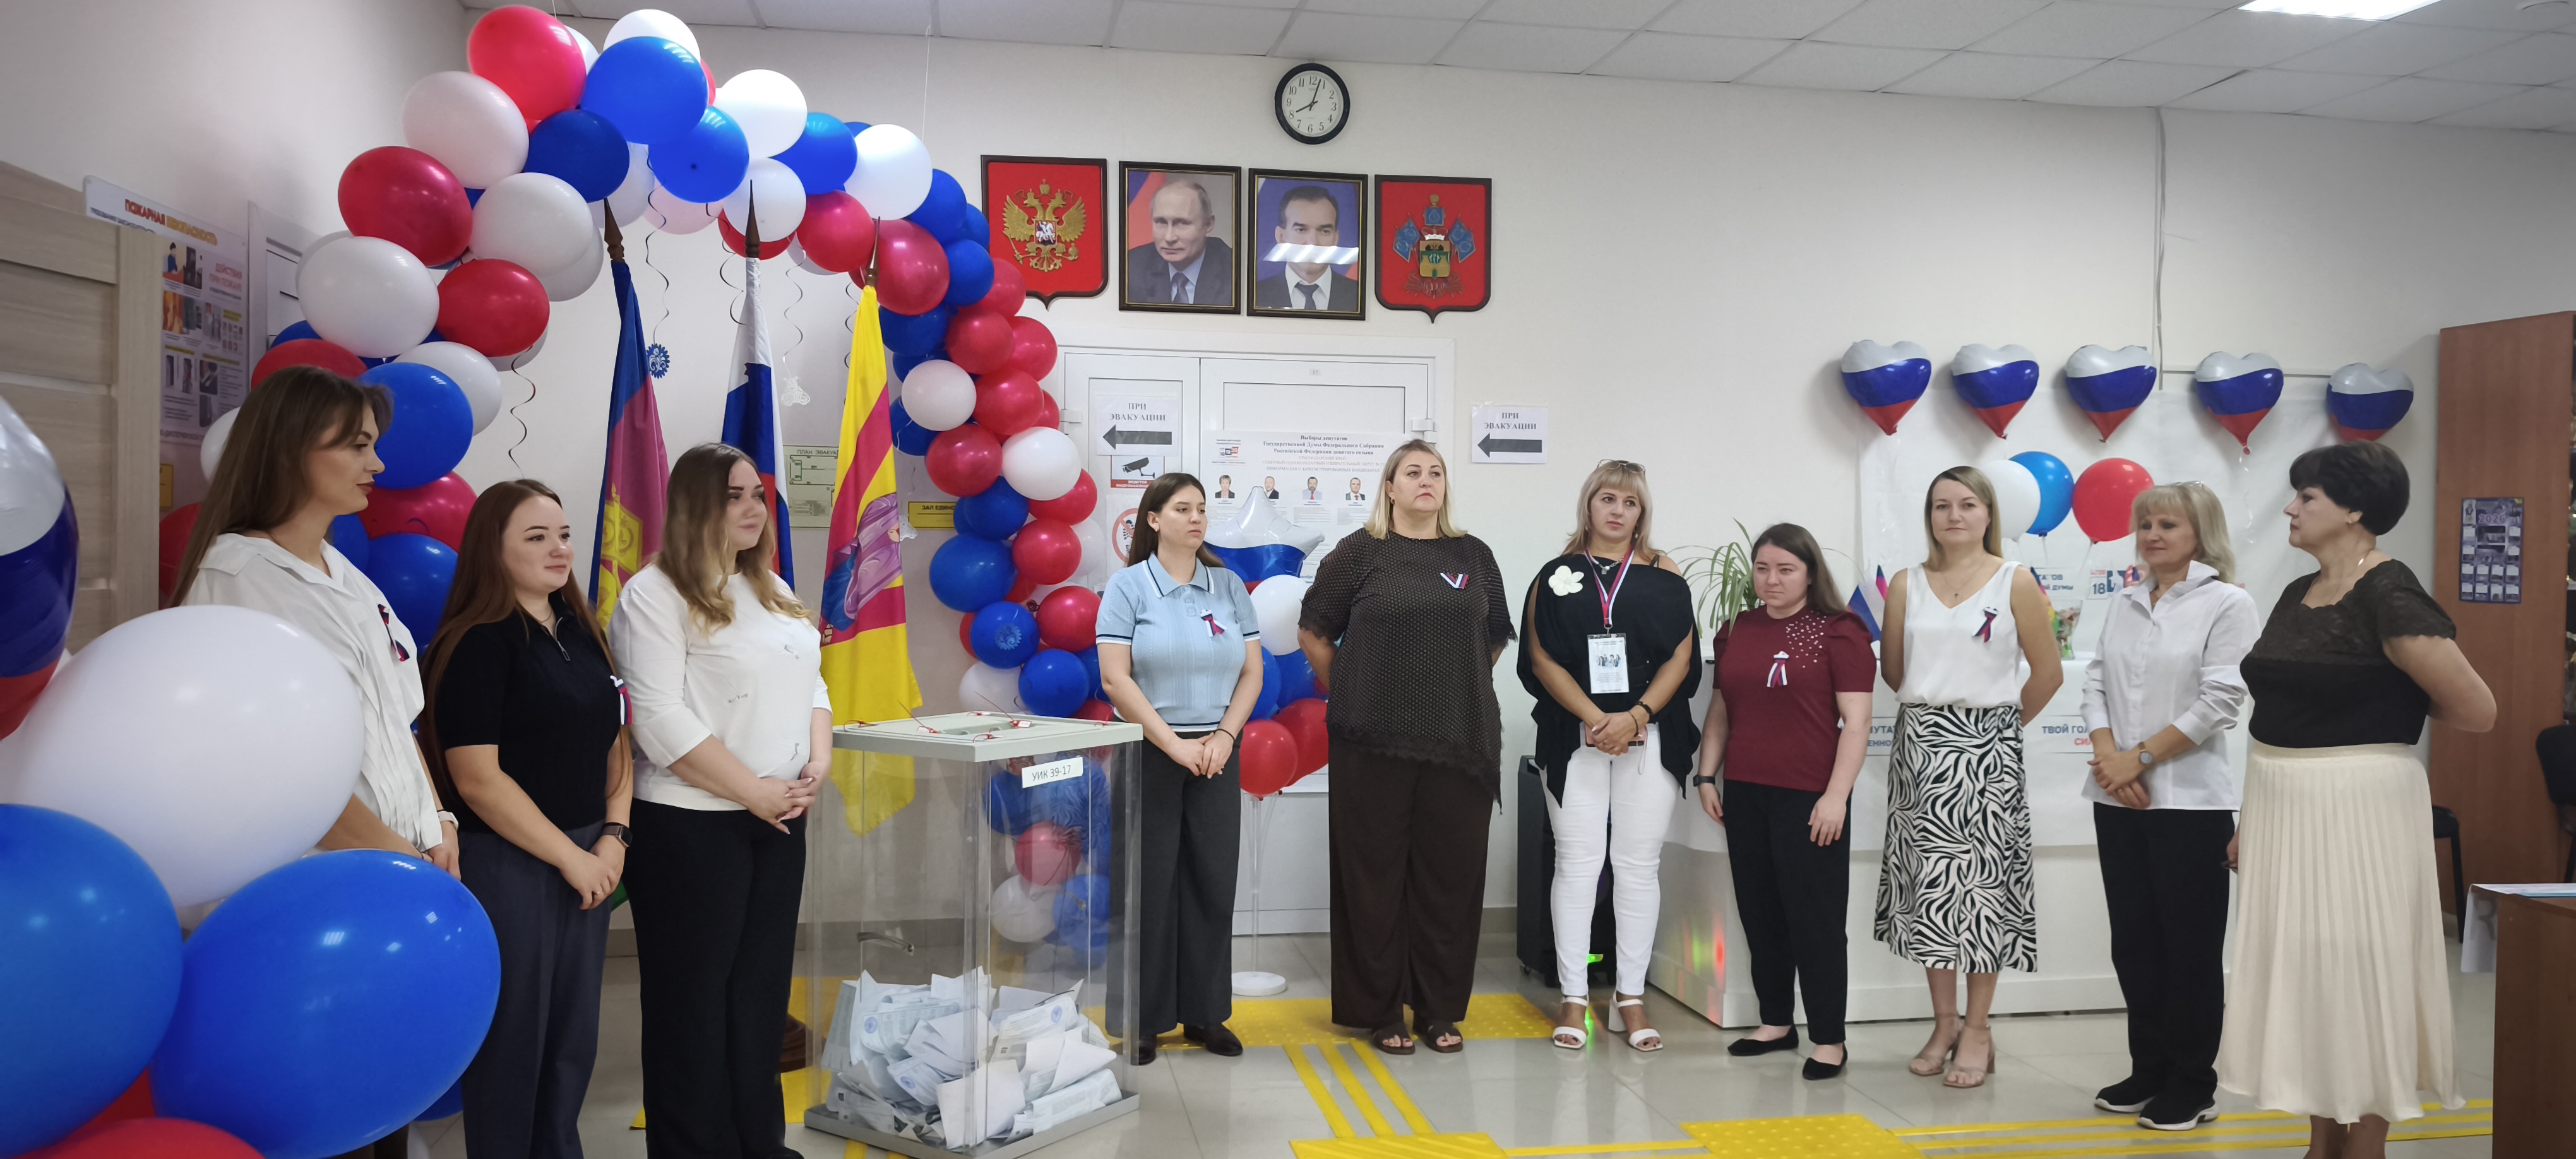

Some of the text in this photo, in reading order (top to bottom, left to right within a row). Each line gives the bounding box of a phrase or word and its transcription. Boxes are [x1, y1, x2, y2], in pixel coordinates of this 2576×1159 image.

[1298, 78, 1304, 87] 11
[1309, 75, 1317, 85] 12
[1323, 80, 1325, 89] 1
[1289, 86, 1297, 95] 10
[1329, 90, 1335, 99] 2
[1286, 98, 1292, 107] 9
[1331, 102, 1337, 111] 3
[1289, 110, 1294, 119] 8
[1328, 114, 1332, 122] 4
[1297, 119, 1301, 128] 7
[1319, 122, 1324, 131] 5
[1308, 124, 1313, 133] 6
[1109, 413, 1166, 422] ЭВАКУАЦИИ
[1484, 422, 1537, 431] ЭВАКУАЦИИ
[2478, 513, 2506, 524] 2026
[2092, 583, 2106, 595] 18
[2042, 724, 2069, 734] ТВОЙ
[1032, 764, 1071, 782] УИК 39-17
